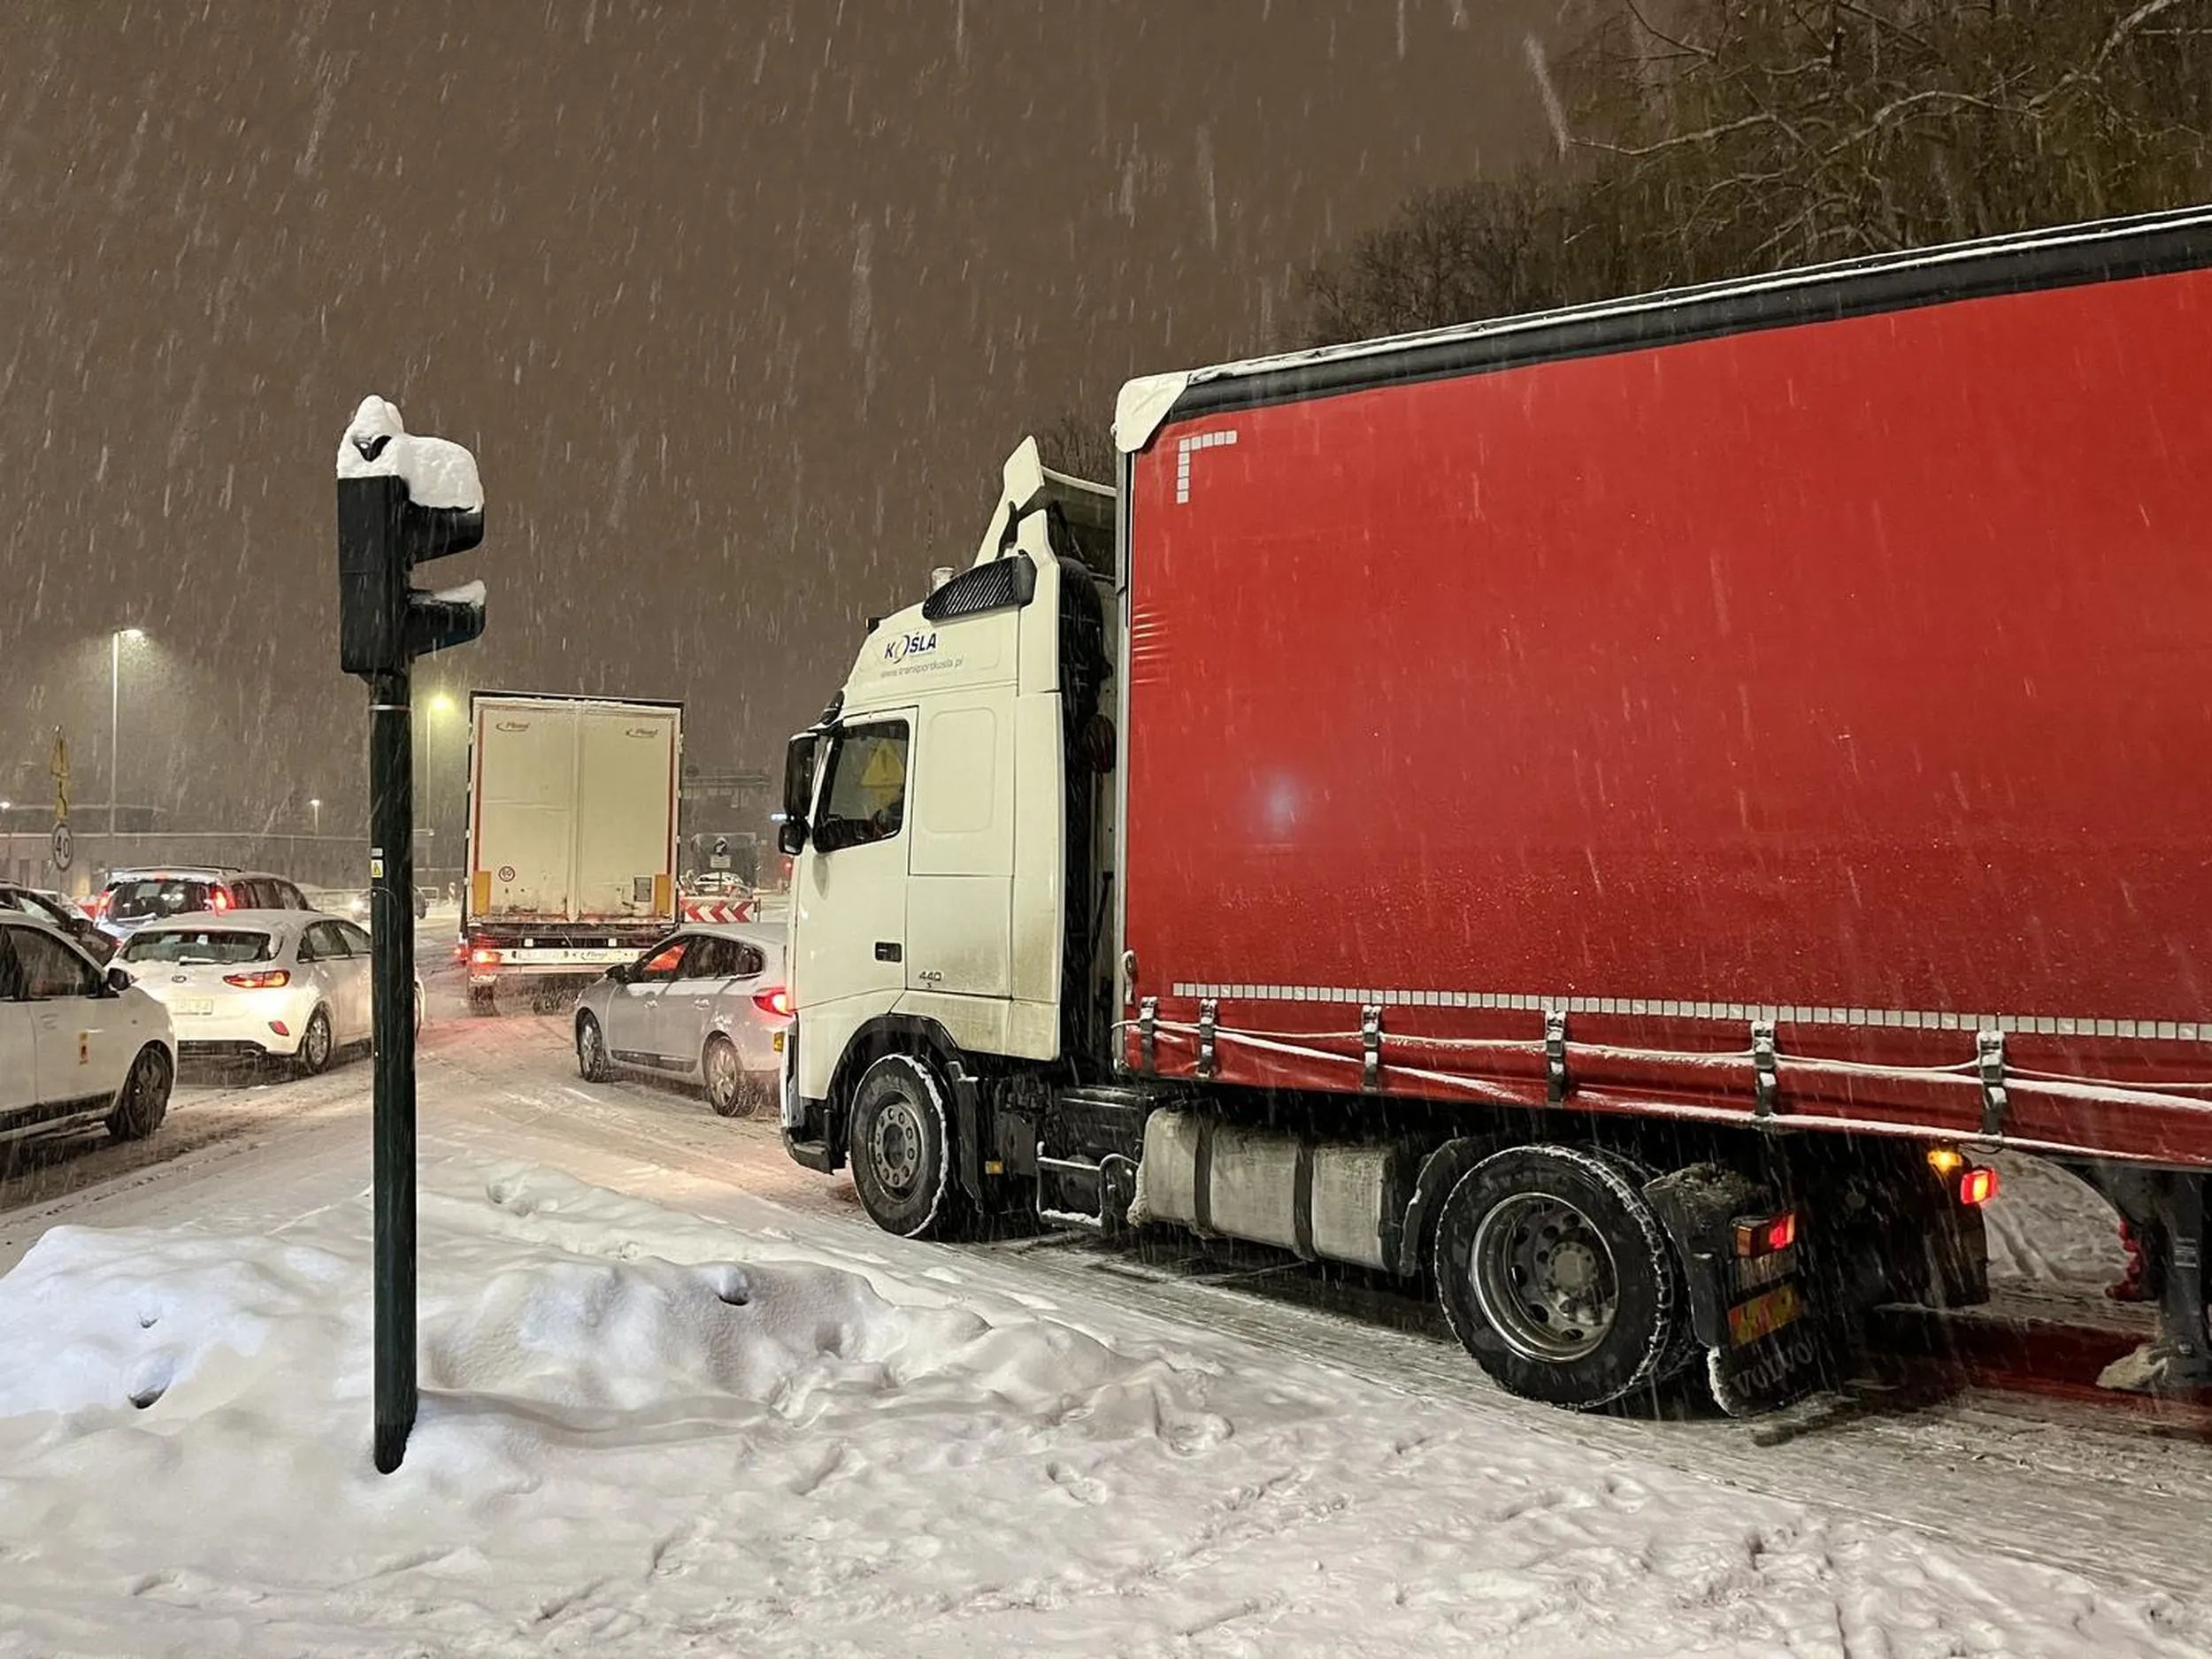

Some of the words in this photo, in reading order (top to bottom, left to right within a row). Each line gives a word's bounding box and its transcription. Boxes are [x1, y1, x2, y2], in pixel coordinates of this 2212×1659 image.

[884, 631, 937, 664] KOŚLA
[56, 835, 69, 858] 40
[919, 972, 942, 981] 440
[1731, 1340, 1812, 1398] VOLVO
